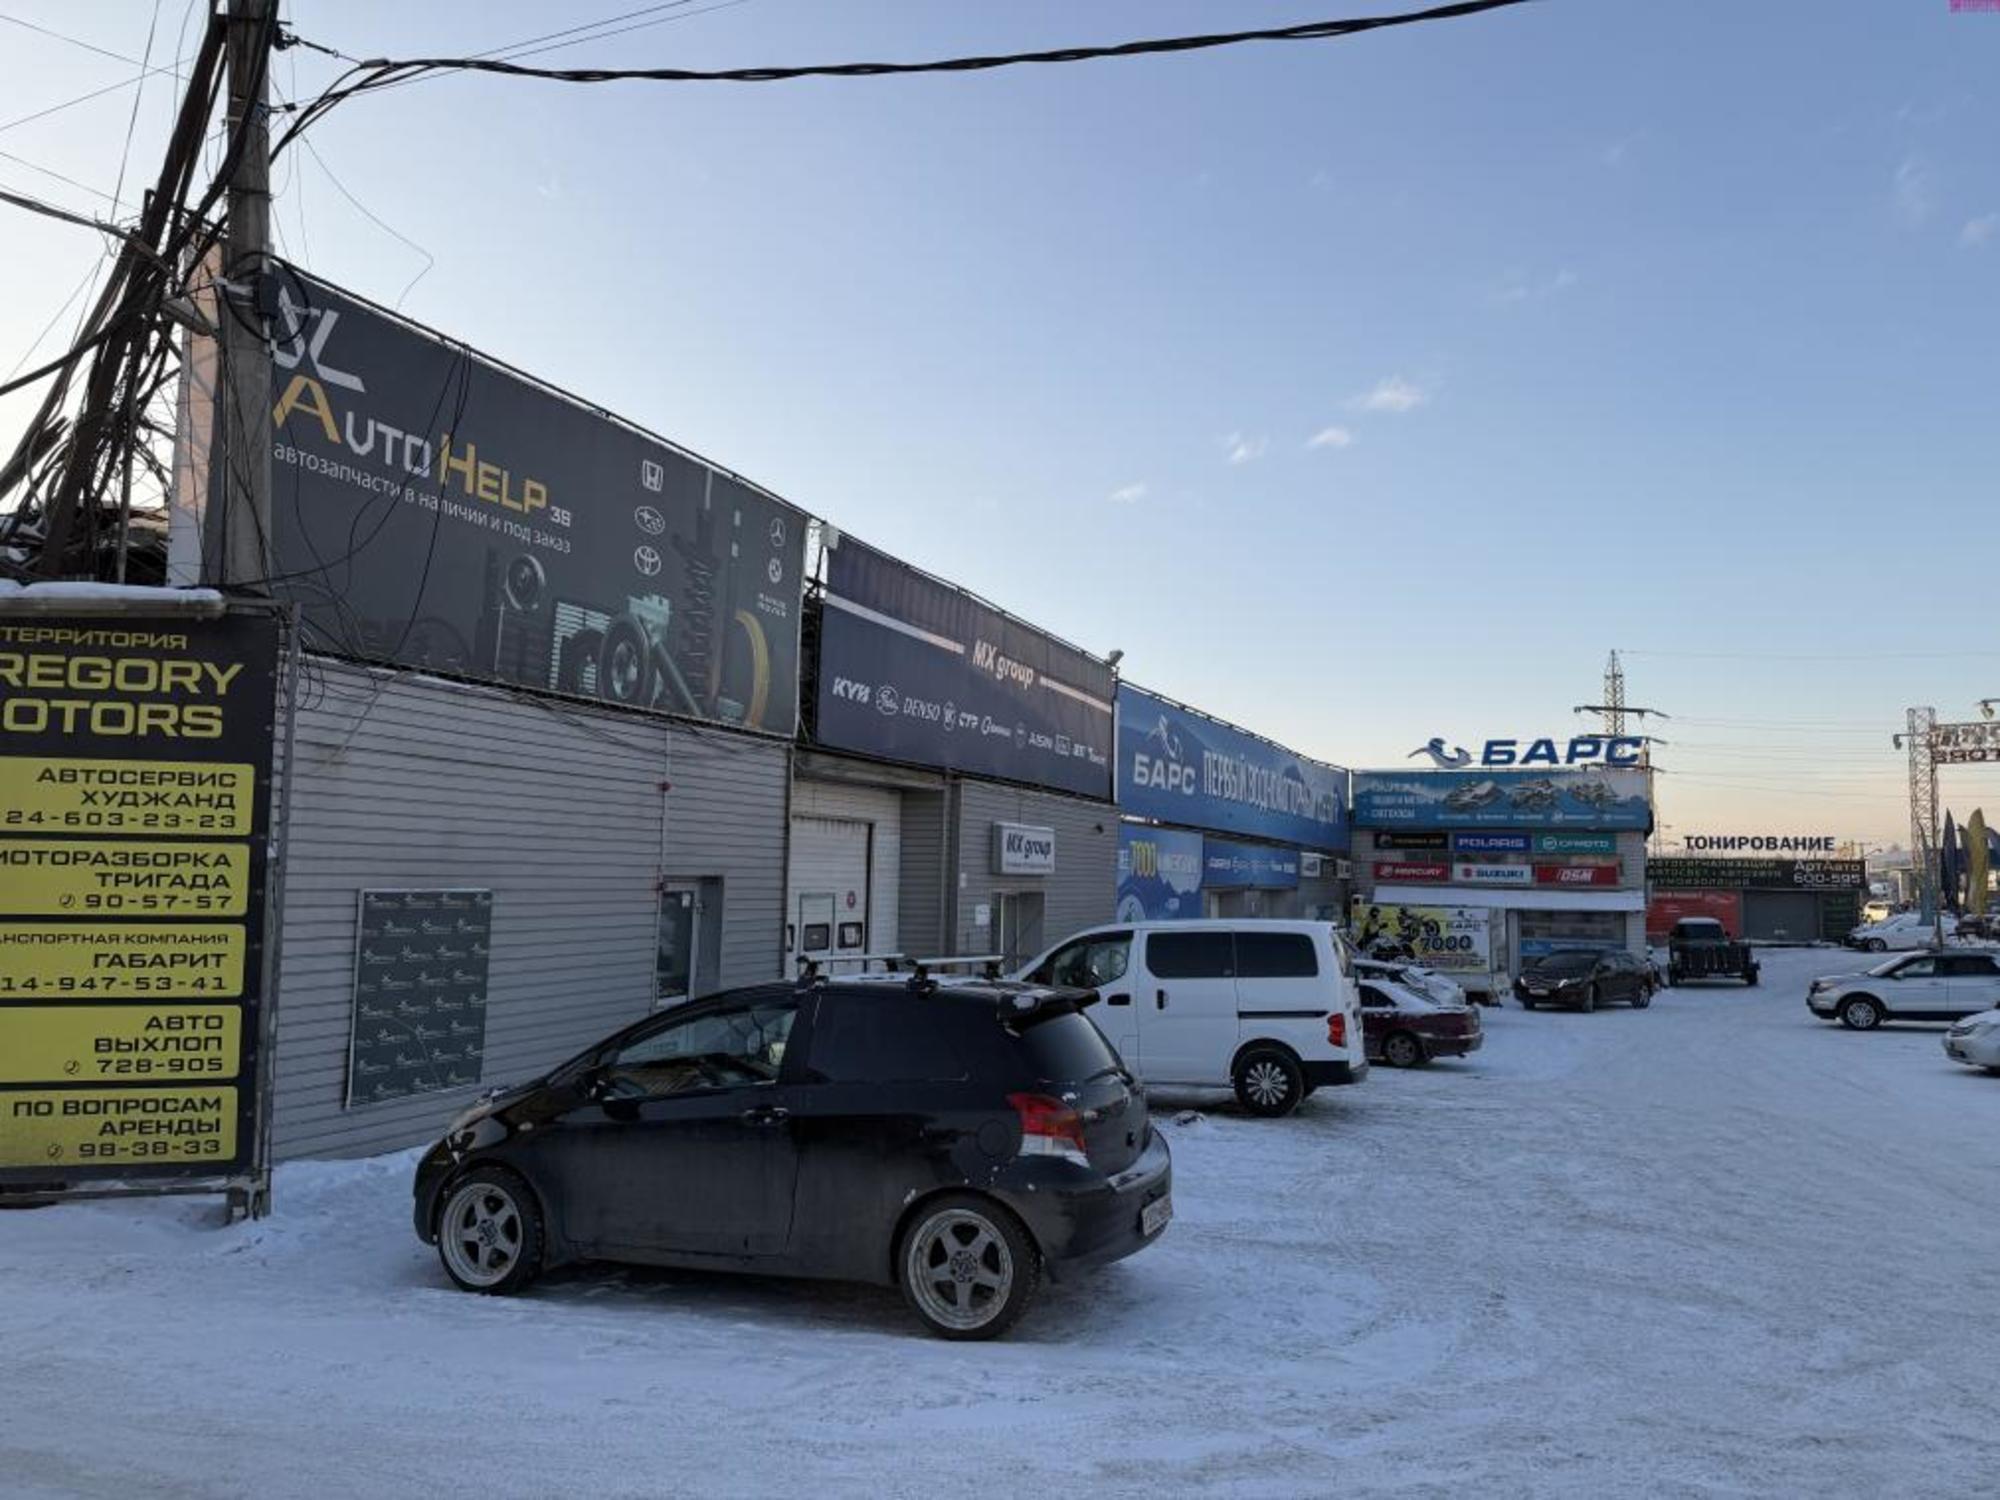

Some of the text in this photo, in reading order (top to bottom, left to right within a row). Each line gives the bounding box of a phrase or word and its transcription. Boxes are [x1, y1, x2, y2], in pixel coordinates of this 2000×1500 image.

[274, 442, 400, 497] автозапчасти
[0, 626, 188, 650] ТЕРРИТОРИЯ
[997, 656, 1034, 690] group
[1481, 736, 1643, 768] БАРС
[37, 768, 237, 788] АВТОСЕРВИС
[1133, 752, 1196, 795] БАРС
[80, 791, 236, 811] ХУДЖАНД
[1458, 838, 1525, 848] POLARIS
[1684, 836, 1836, 851] ТОНИРОВАНИЕ
[96, 873, 230, 890] ТРИГАДА
[1476, 869, 1524, 878] SUZUKI
[85, 895, 233, 908] 90-57-57
[0, 933, 229, 945] НСПОРТНАЯ КОМПАНИЯ
[93, 953, 228, 968] ГАБАРИТ
[145, 1015, 223, 1030] АВТО
[94, 1036, 223, 1053] ВЫХЛОП
[97, 1058, 223, 1073] 728-905
[13, 1098, 221, 1117] ПО ВОПРОСАМ
[99, 1119, 221, 1136] АРЕНДЫ
[79, 1140, 221, 1158] 98-38-33
